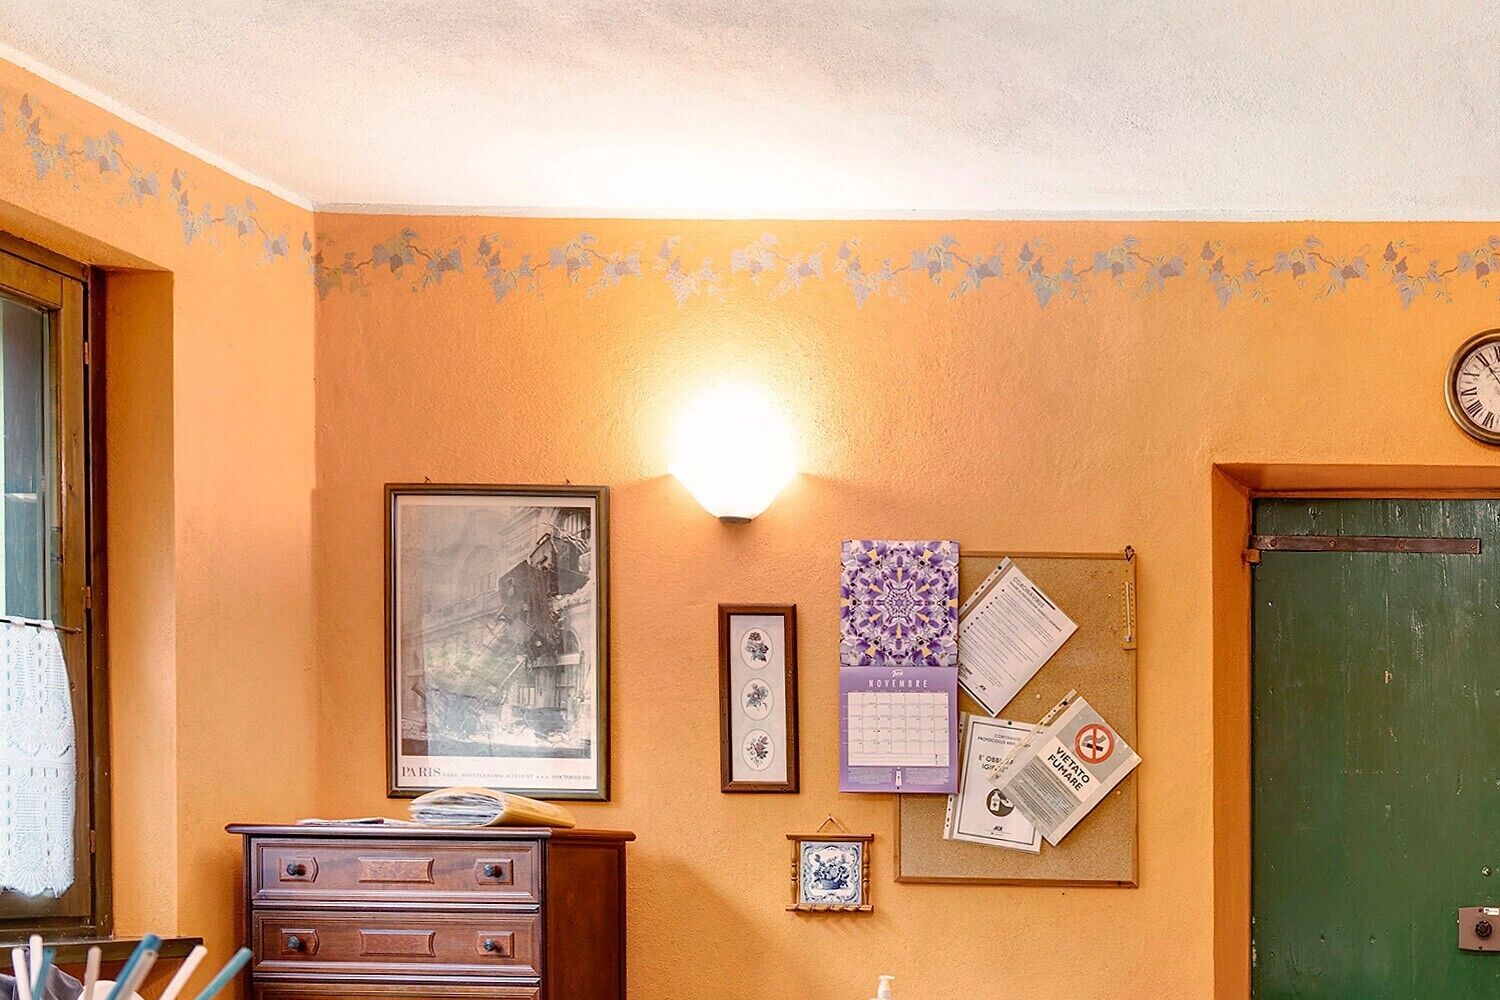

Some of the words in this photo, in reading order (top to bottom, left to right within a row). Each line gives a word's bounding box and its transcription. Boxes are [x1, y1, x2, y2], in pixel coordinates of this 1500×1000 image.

[868, 678, 928, 688] NOVEMBRE
[402, 766, 441, 778] PARIS
[1047, 754, 1083, 791] FUMARE
[1056, 746, 1090, 783] VIETATO
